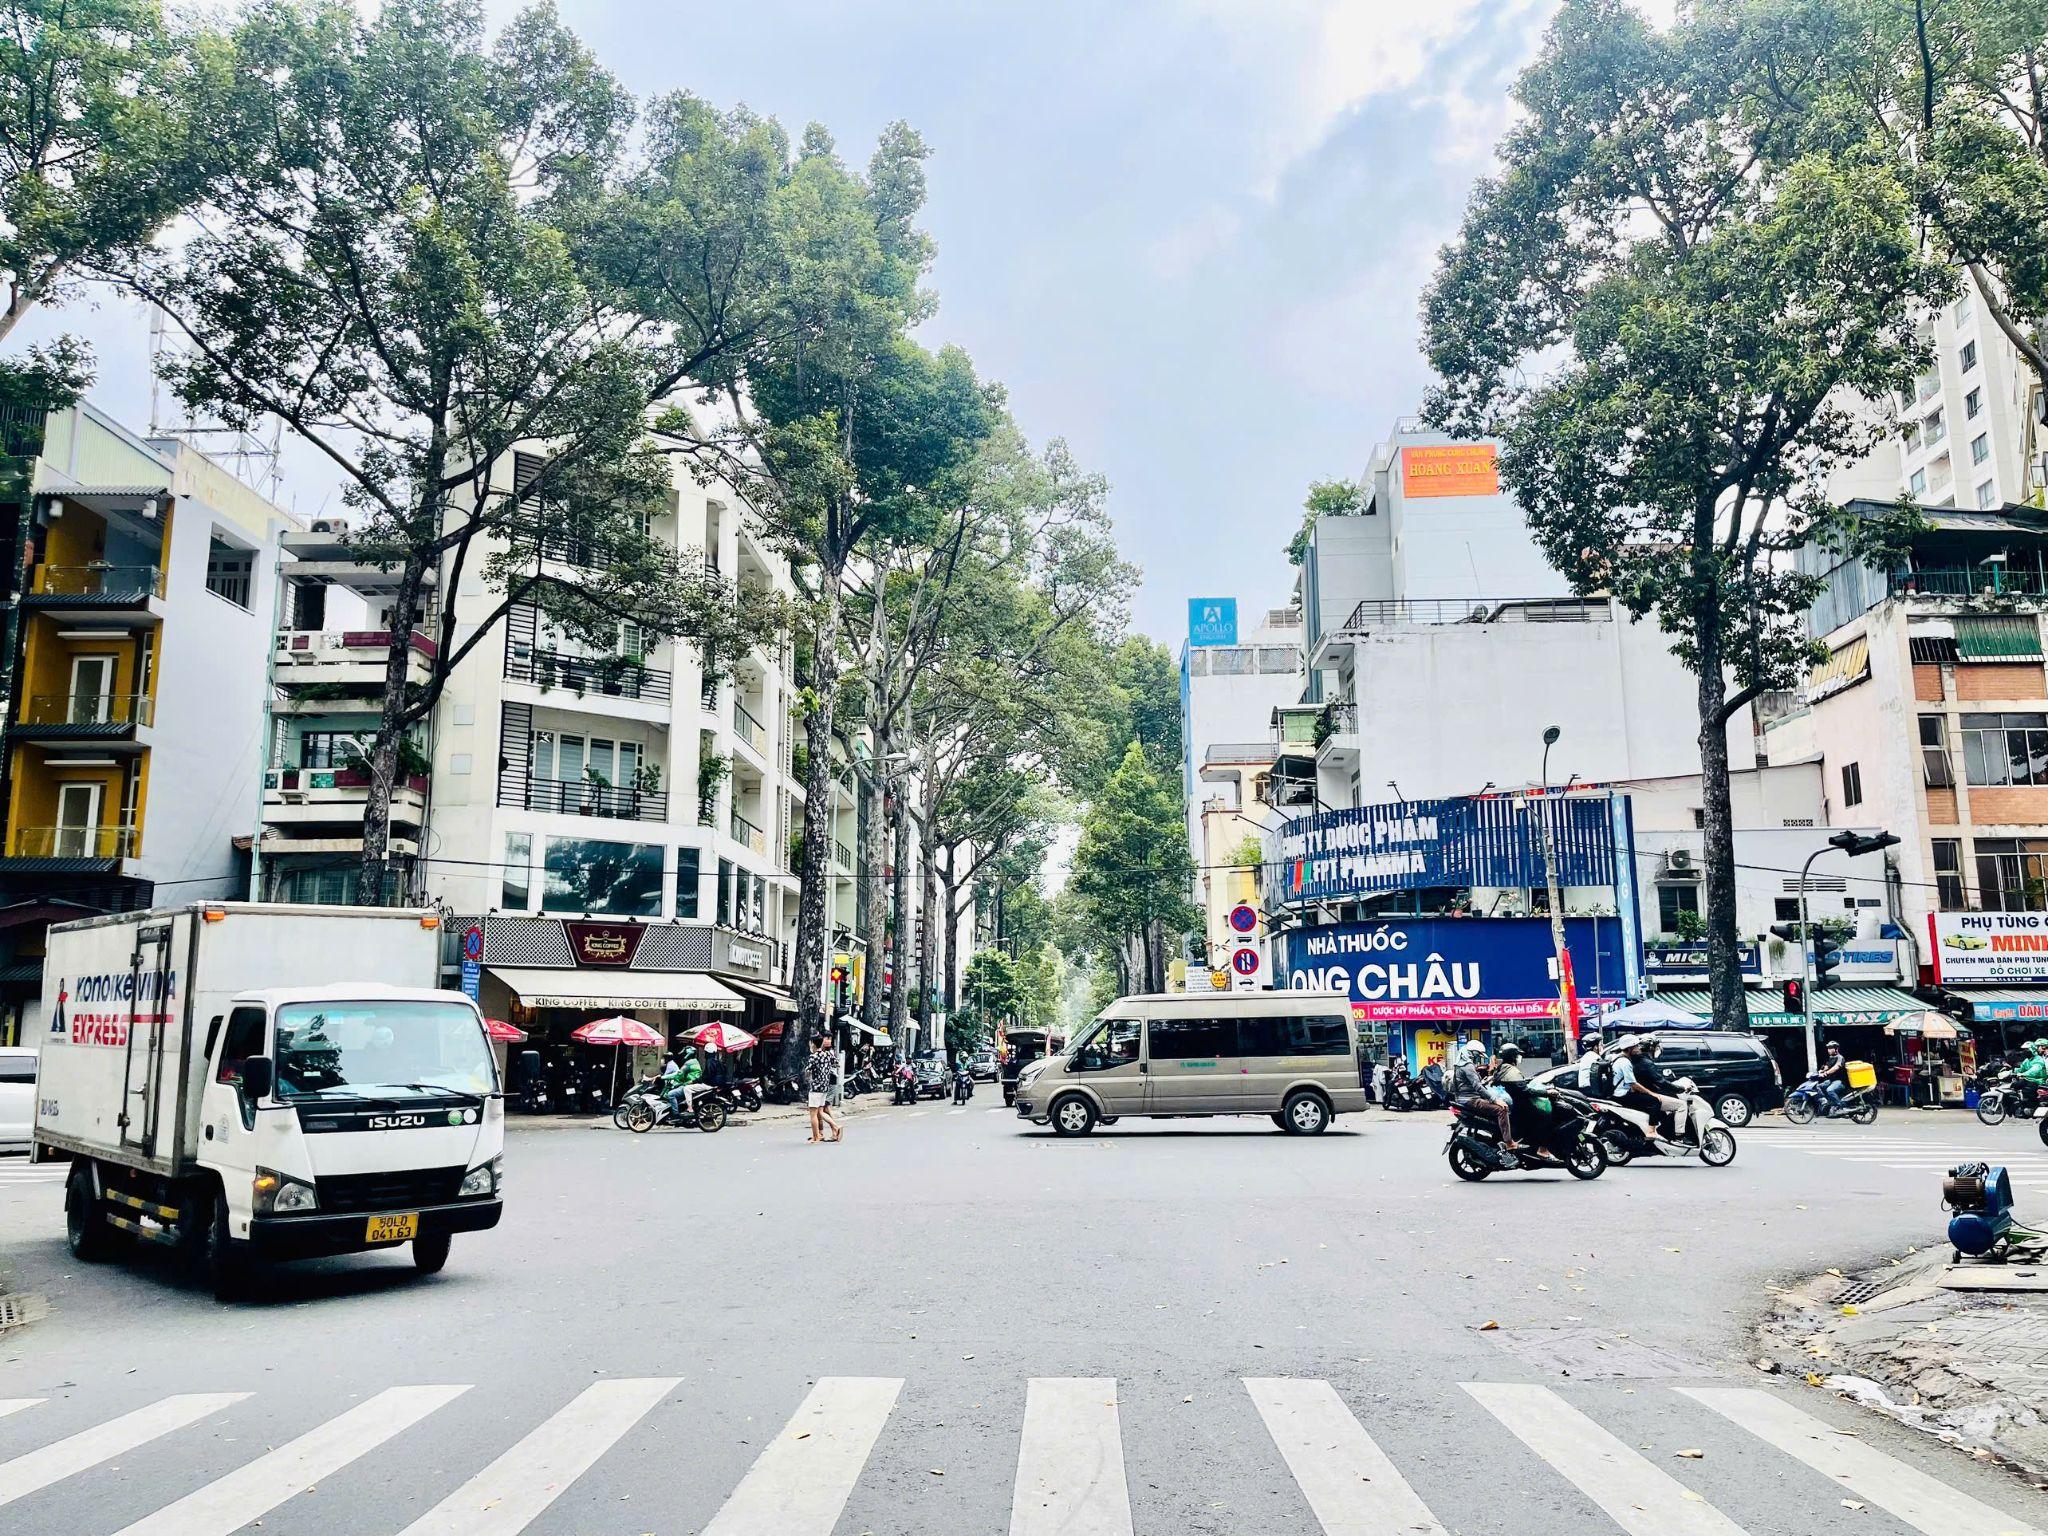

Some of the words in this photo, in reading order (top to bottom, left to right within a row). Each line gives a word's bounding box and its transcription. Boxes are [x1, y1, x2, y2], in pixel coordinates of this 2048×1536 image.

[1193, 623, 1233, 633] APOLLO
[1313, 857, 1338, 882] FPT
[1617, 827, 1629, 899] LONG
[1961, 916, 1992, 932] PHỤ
[1997, 913, 2039, 928] TÙNG
[1307, 931, 1338, 955] NHÀ
[1338, 924, 1408, 953] THUỐC
[1843, 951, 1894, 964] TIRES
[1357, 952, 1481, 1000] CHÂU
[2034, 966, 2045, 974] XE
[535, 998, 560, 1006] KING
[563, 999, 598, 1007] COFFEE
[608, 1000, 631, 1008] KING
[634, 1000, 667, 1008] COFFEE
[72, 1013, 128, 1046] EXPRESS
[368, 1115, 426, 1129] ISUZU
[371, 1227, 412, 1241] 041.63
